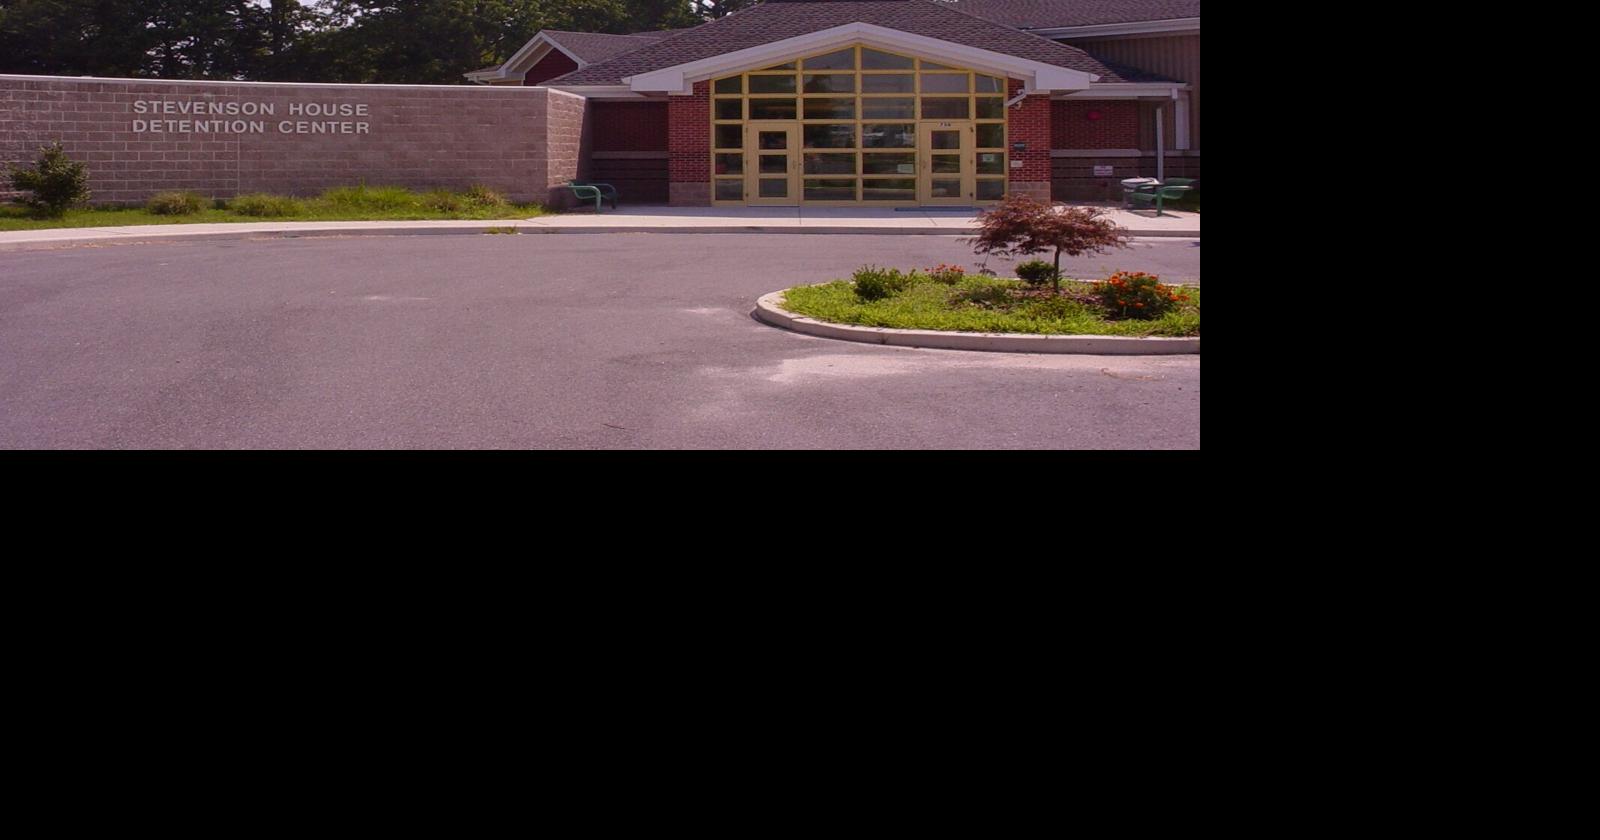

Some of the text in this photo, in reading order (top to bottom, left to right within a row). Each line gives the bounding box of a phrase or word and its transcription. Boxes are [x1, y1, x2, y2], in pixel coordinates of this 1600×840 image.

[133, 100, 369, 116] STEVENSON HOUSE
[132, 119, 370, 134] DETENTION CENTER
